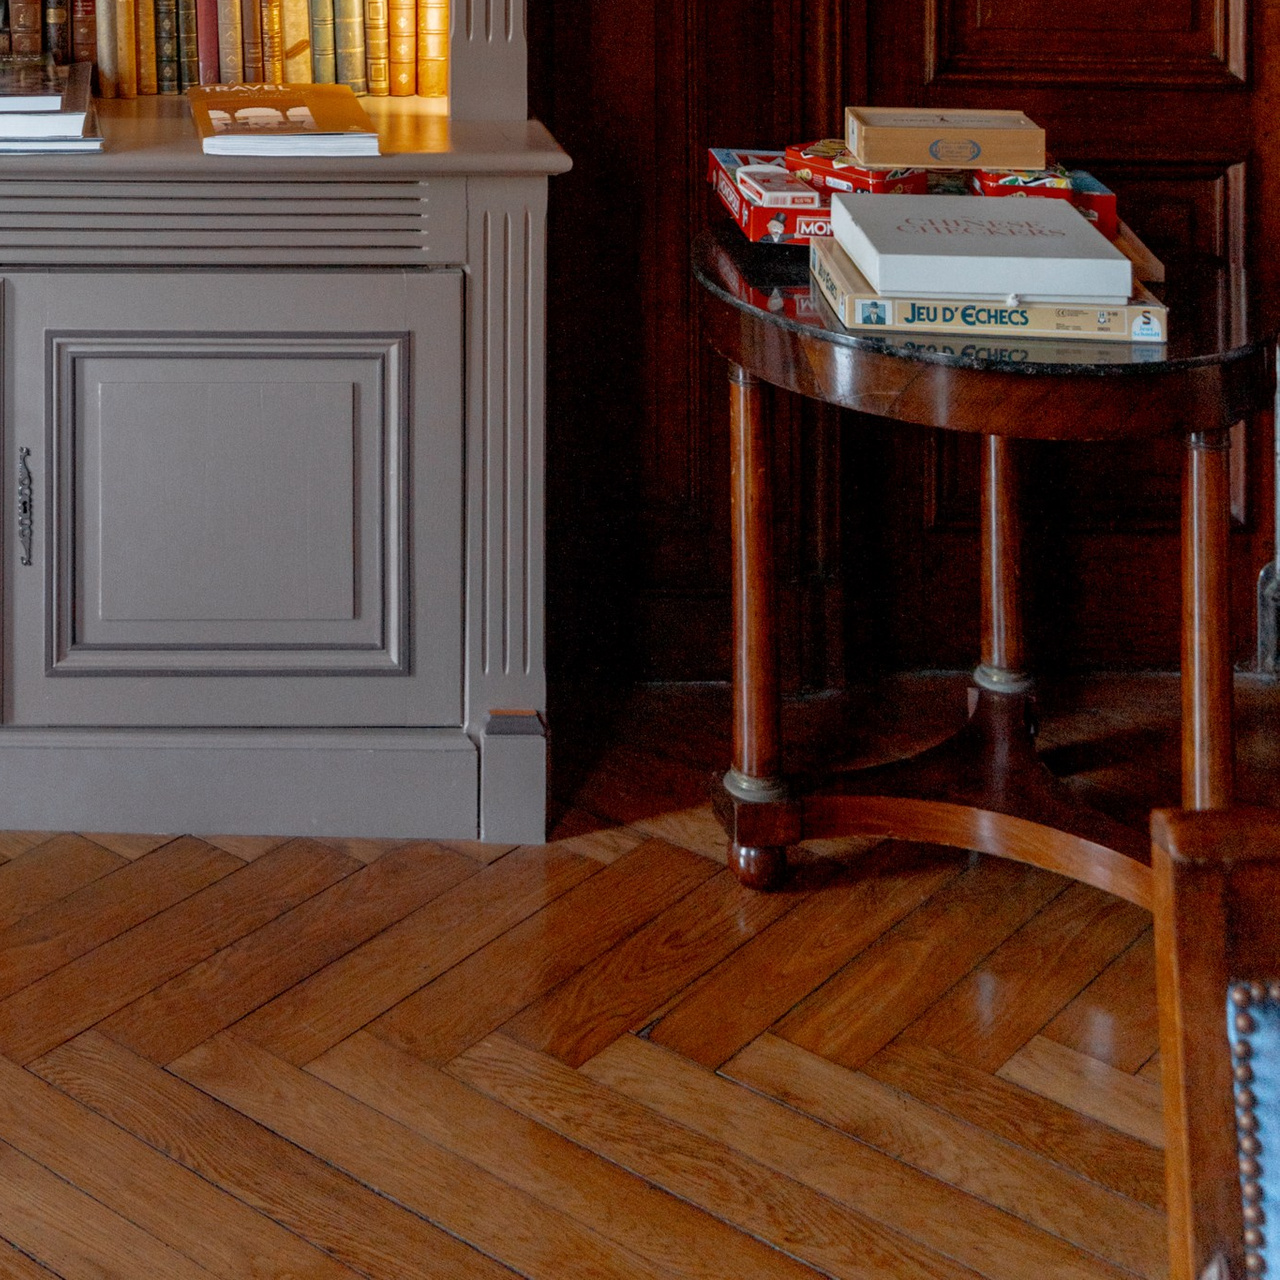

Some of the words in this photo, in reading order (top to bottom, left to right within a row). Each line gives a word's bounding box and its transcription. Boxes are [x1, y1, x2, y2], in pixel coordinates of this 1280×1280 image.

[200, 84, 291, 93] TRAVEL
[904, 217, 1046, 230] CHINESE
[897, 225, 1066, 237] CHECKERS
[904, 302, 938, 323] JEU
